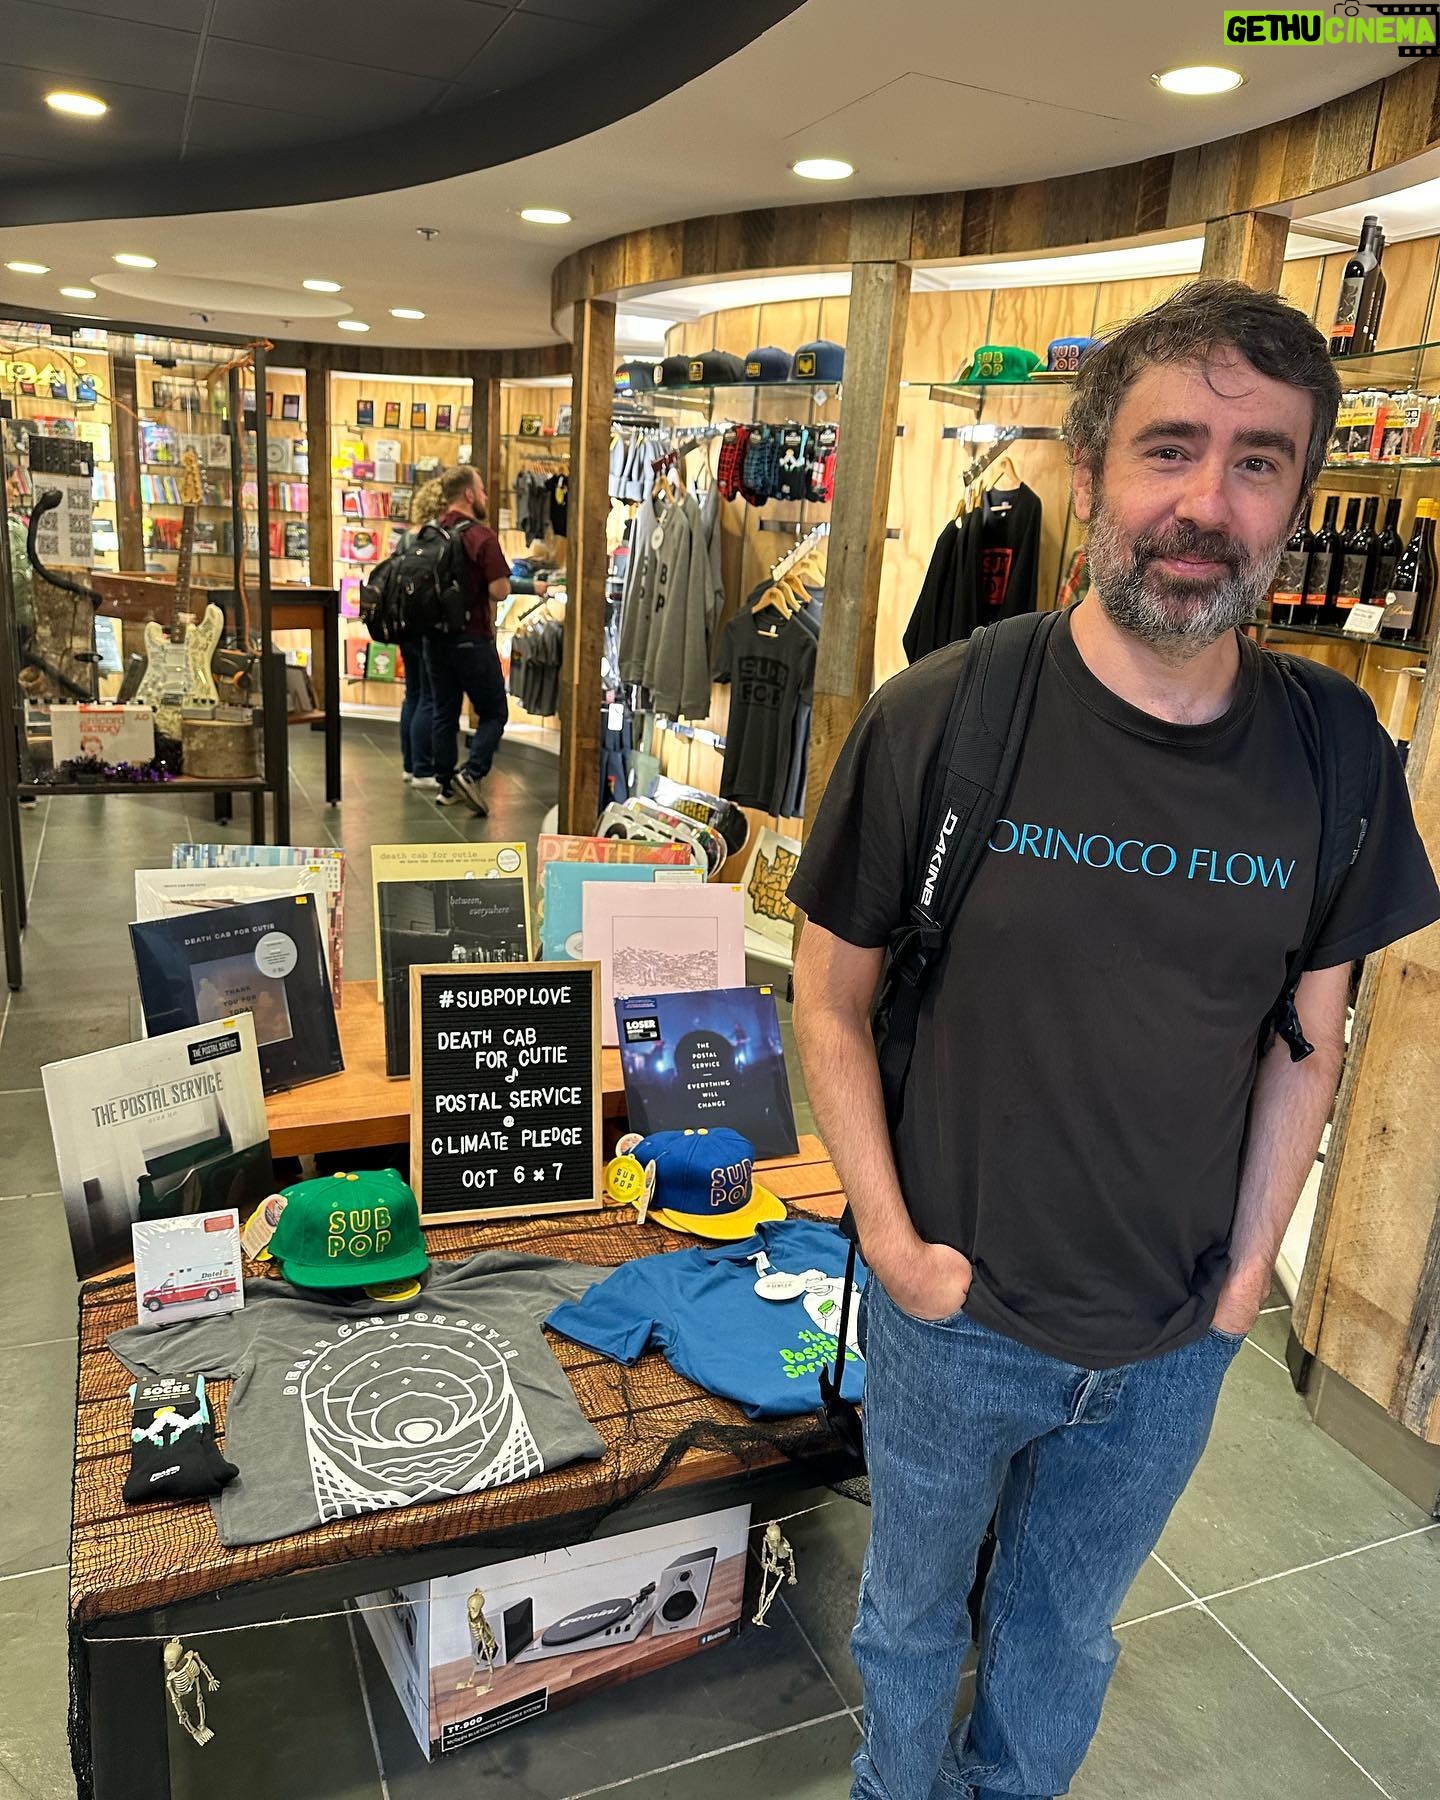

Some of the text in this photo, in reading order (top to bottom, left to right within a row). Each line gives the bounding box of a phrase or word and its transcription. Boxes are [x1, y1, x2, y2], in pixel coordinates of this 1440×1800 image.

[976, 363, 1003, 377] OP
[1053, 358, 1079, 371] OP
[433, 851, 447, 859] for
[542, 839, 635, 864] DEATH
[921, 807, 958, 906] DAKINE
[988, 819, 1296, 890] ORINOCO FLOW
[184, 923, 275, 946] DEATH CAB FOR CUTIE
[626, 1020, 656, 1030] LOSER
[437, 1028, 537, 1050] DEATH CAB
[475, 1046, 568, 1070] FOR CUTIE
[691, 1061, 720, 1070] SERVICE
[687, 1079, 731, 1090] EVERYTHING
[91, 1071, 224, 1127] THE POSTAL SERVICE
[435, 1086, 582, 1114] POSTAL SERVICE
[697, 1100, 726, 1109] CHANGE
[431, 1127, 582, 1156] CLIMATE PLEDGE
[462, 1169, 498, 1189] OCT
[513, 1165, 525, 1184] 6
[552, 1162, 564, 1181] 7
[613, 1177, 633, 1190] POP
[616, 1168, 636, 1181] SUB
[711, 1183, 749, 1207] PO
[329, 1207, 392, 1234] SUB
[328, 1230, 392, 1257] POP
[283, 1312, 520, 1396] DEATH CAB FOR CUTIE
[143, 1383, 191, 1397] SOCKS
[447, 1716, 483, 1733] TT-900
